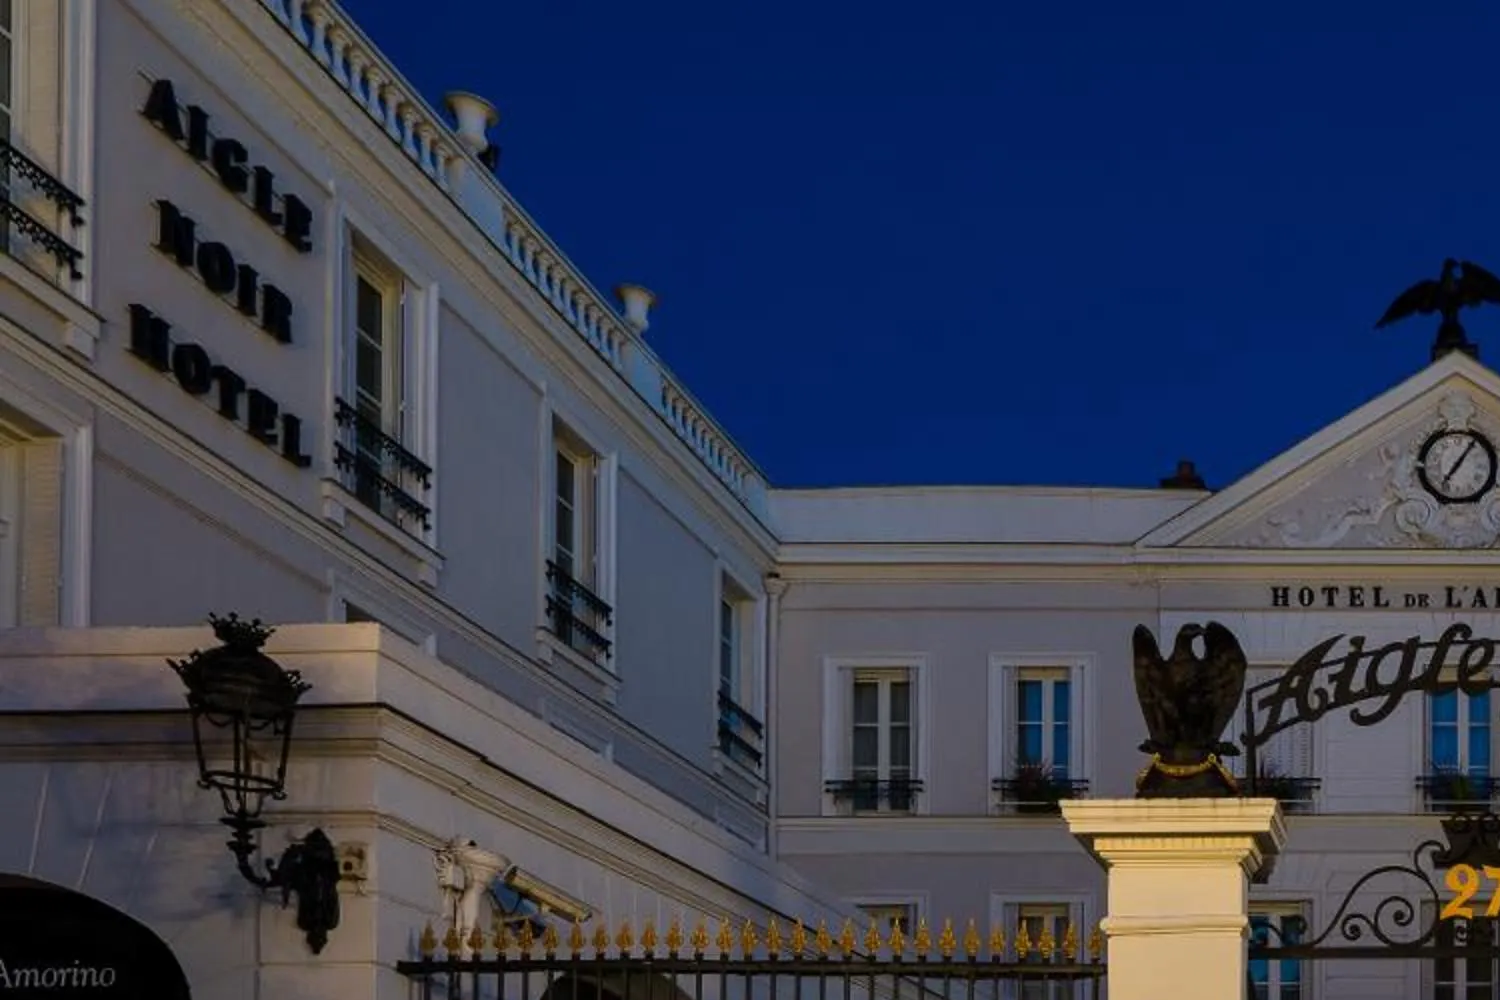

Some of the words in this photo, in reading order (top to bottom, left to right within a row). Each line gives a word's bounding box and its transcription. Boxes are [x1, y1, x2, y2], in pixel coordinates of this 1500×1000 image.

[141, 79, 312, 253] AIGLE
[154, 199, 293, 344] NOIR
[127, 303, 312, 468] HOTEL
[1271, 585, 1390, 608] HOTEL
[1240, 622, 1496, 745] Aigle
